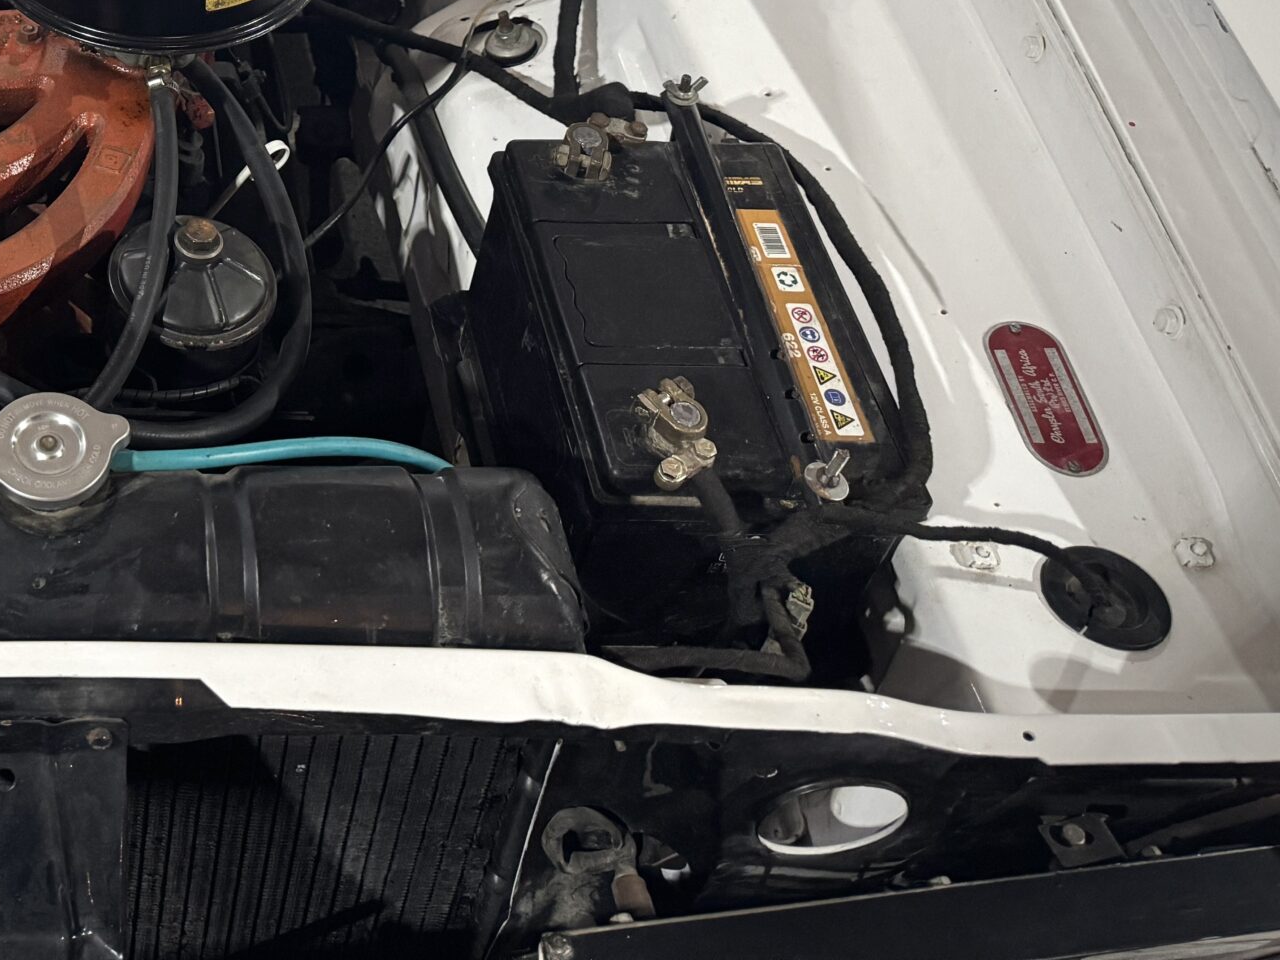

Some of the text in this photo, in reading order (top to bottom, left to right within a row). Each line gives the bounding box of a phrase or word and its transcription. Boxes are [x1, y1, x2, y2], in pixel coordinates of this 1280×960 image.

[782, 332, 802, 359] 622
[71, 404, 90, 420] HOT
[809, 392, 819, 406] 12V
[814, 406, 830, 430] CLASS
[1018, 349, 1065, 444] Chrysler South Africa
